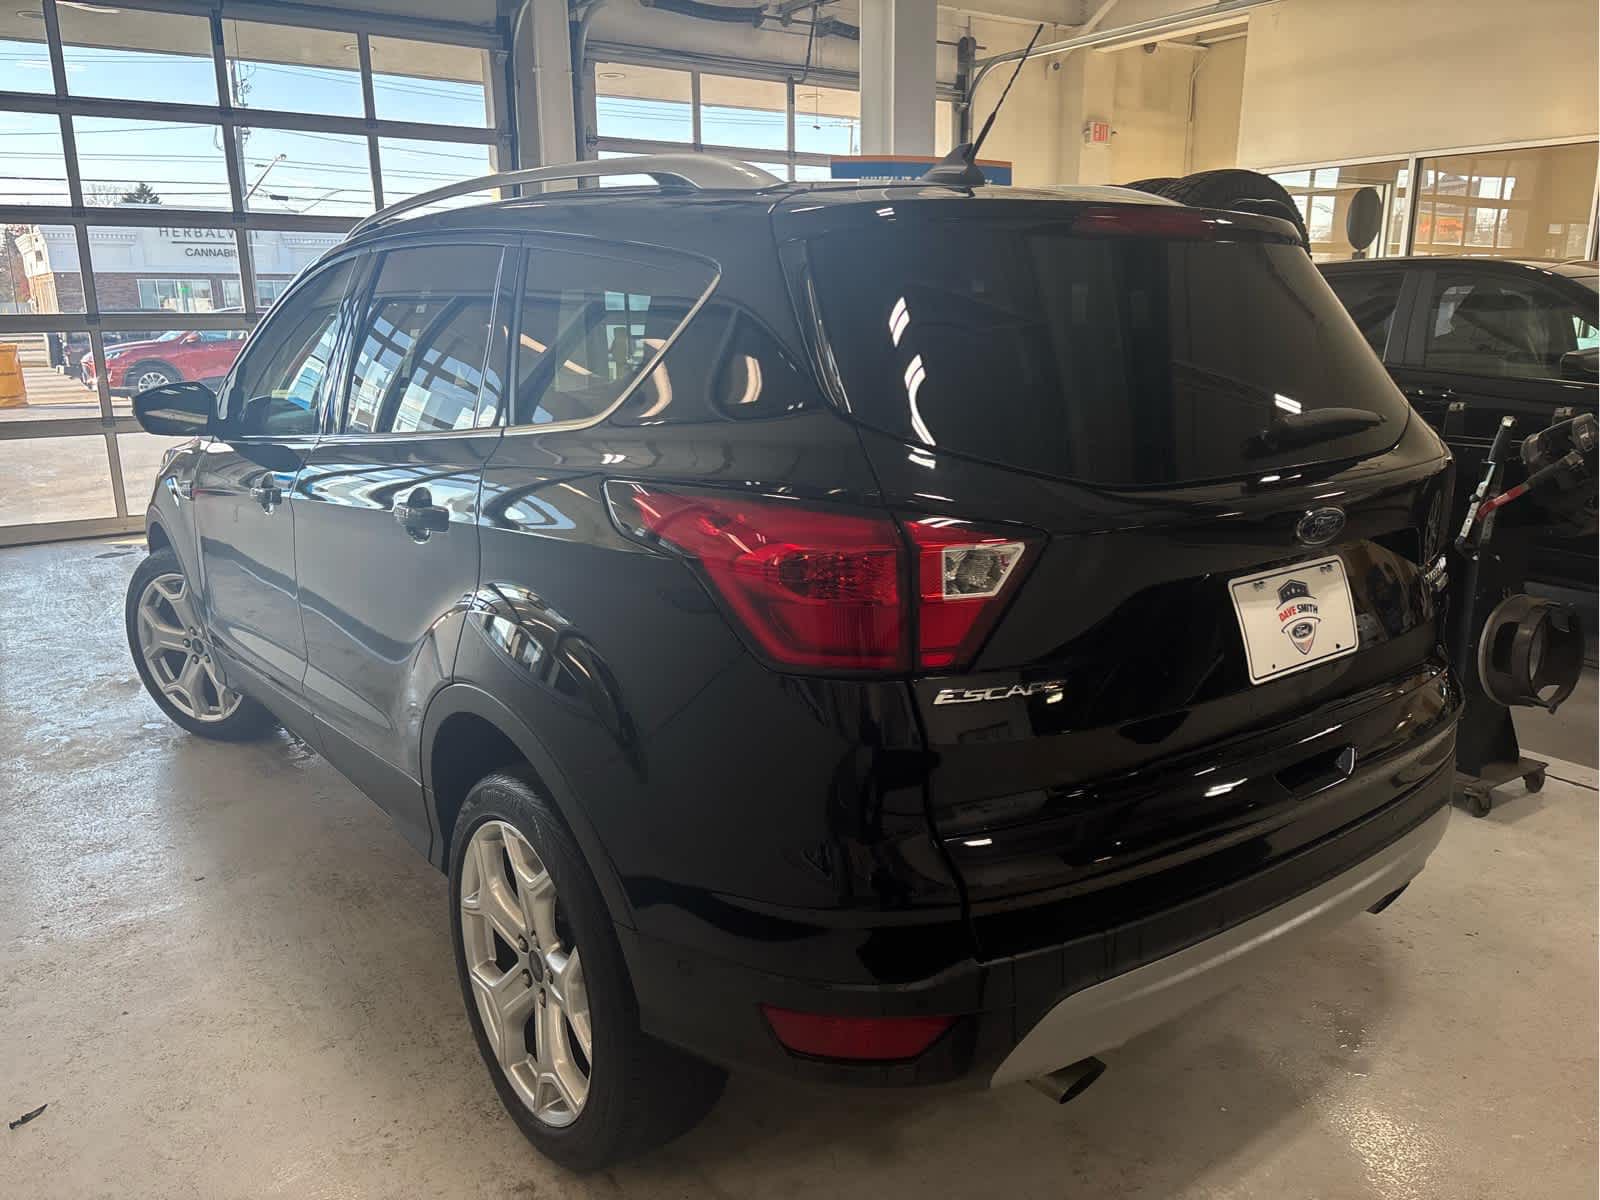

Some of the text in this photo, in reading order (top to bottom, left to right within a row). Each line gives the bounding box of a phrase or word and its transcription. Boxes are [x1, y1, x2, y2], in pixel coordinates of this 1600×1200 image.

[1279, 603, 1318, 621] DAVE SMITH
[933, 680, 1066, 704] ESCAPE
